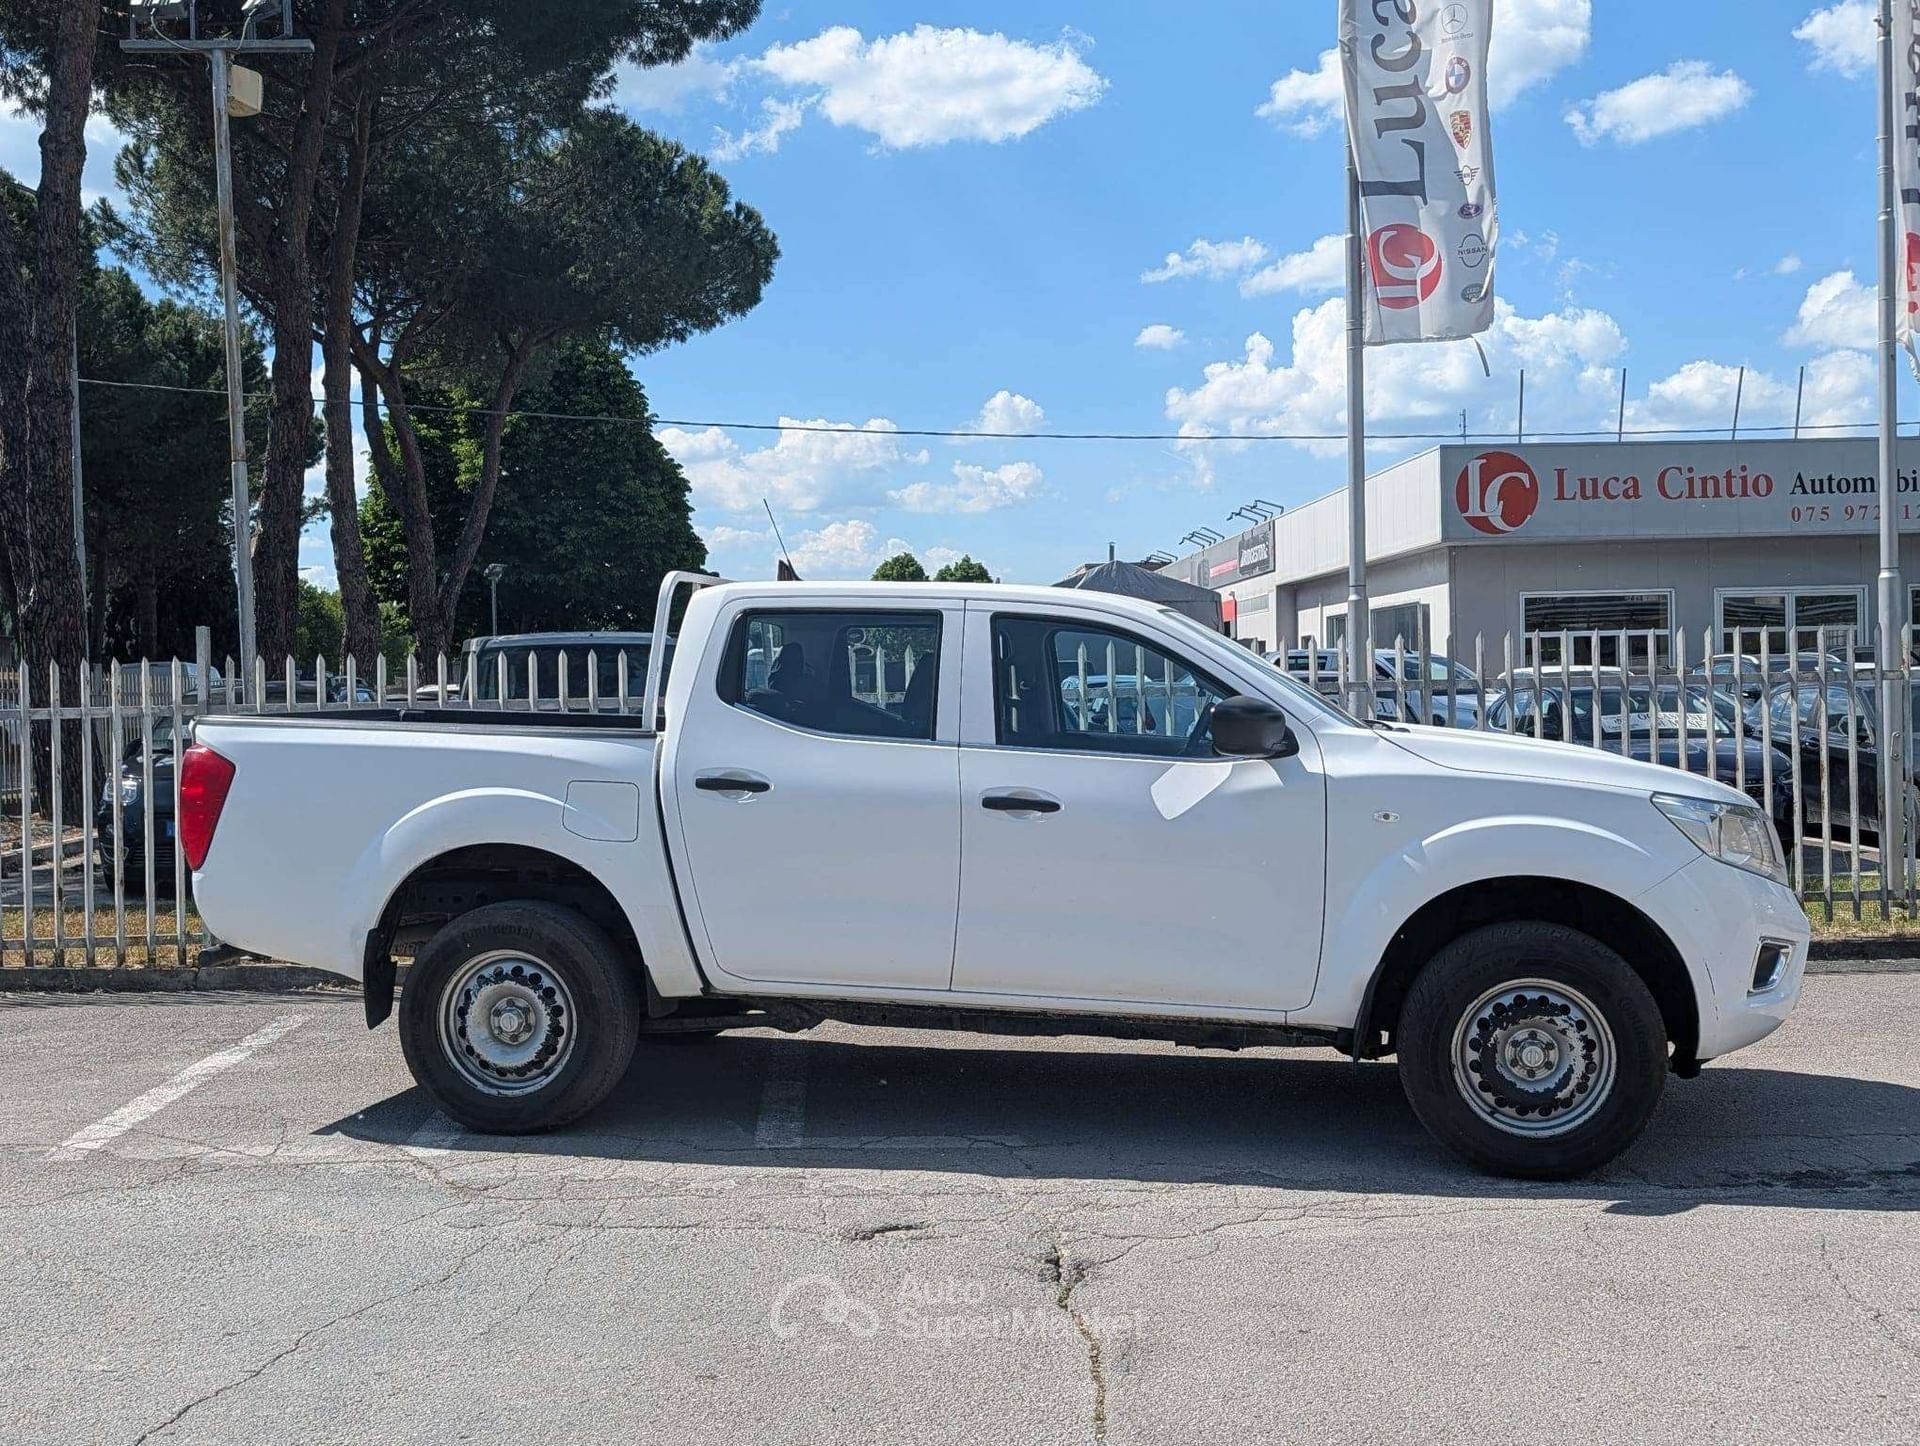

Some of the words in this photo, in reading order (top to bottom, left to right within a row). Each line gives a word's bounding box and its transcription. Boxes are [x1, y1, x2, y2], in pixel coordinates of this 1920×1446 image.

[1457, 246, 1488, 255] NISSAN
[1553, 467, 1643, 500] Luca
[1657, 464, 1774, 500] Cintio
[1789, 468, 1920, 495] Autombi
[1791, 505, 1830, 522] 075
